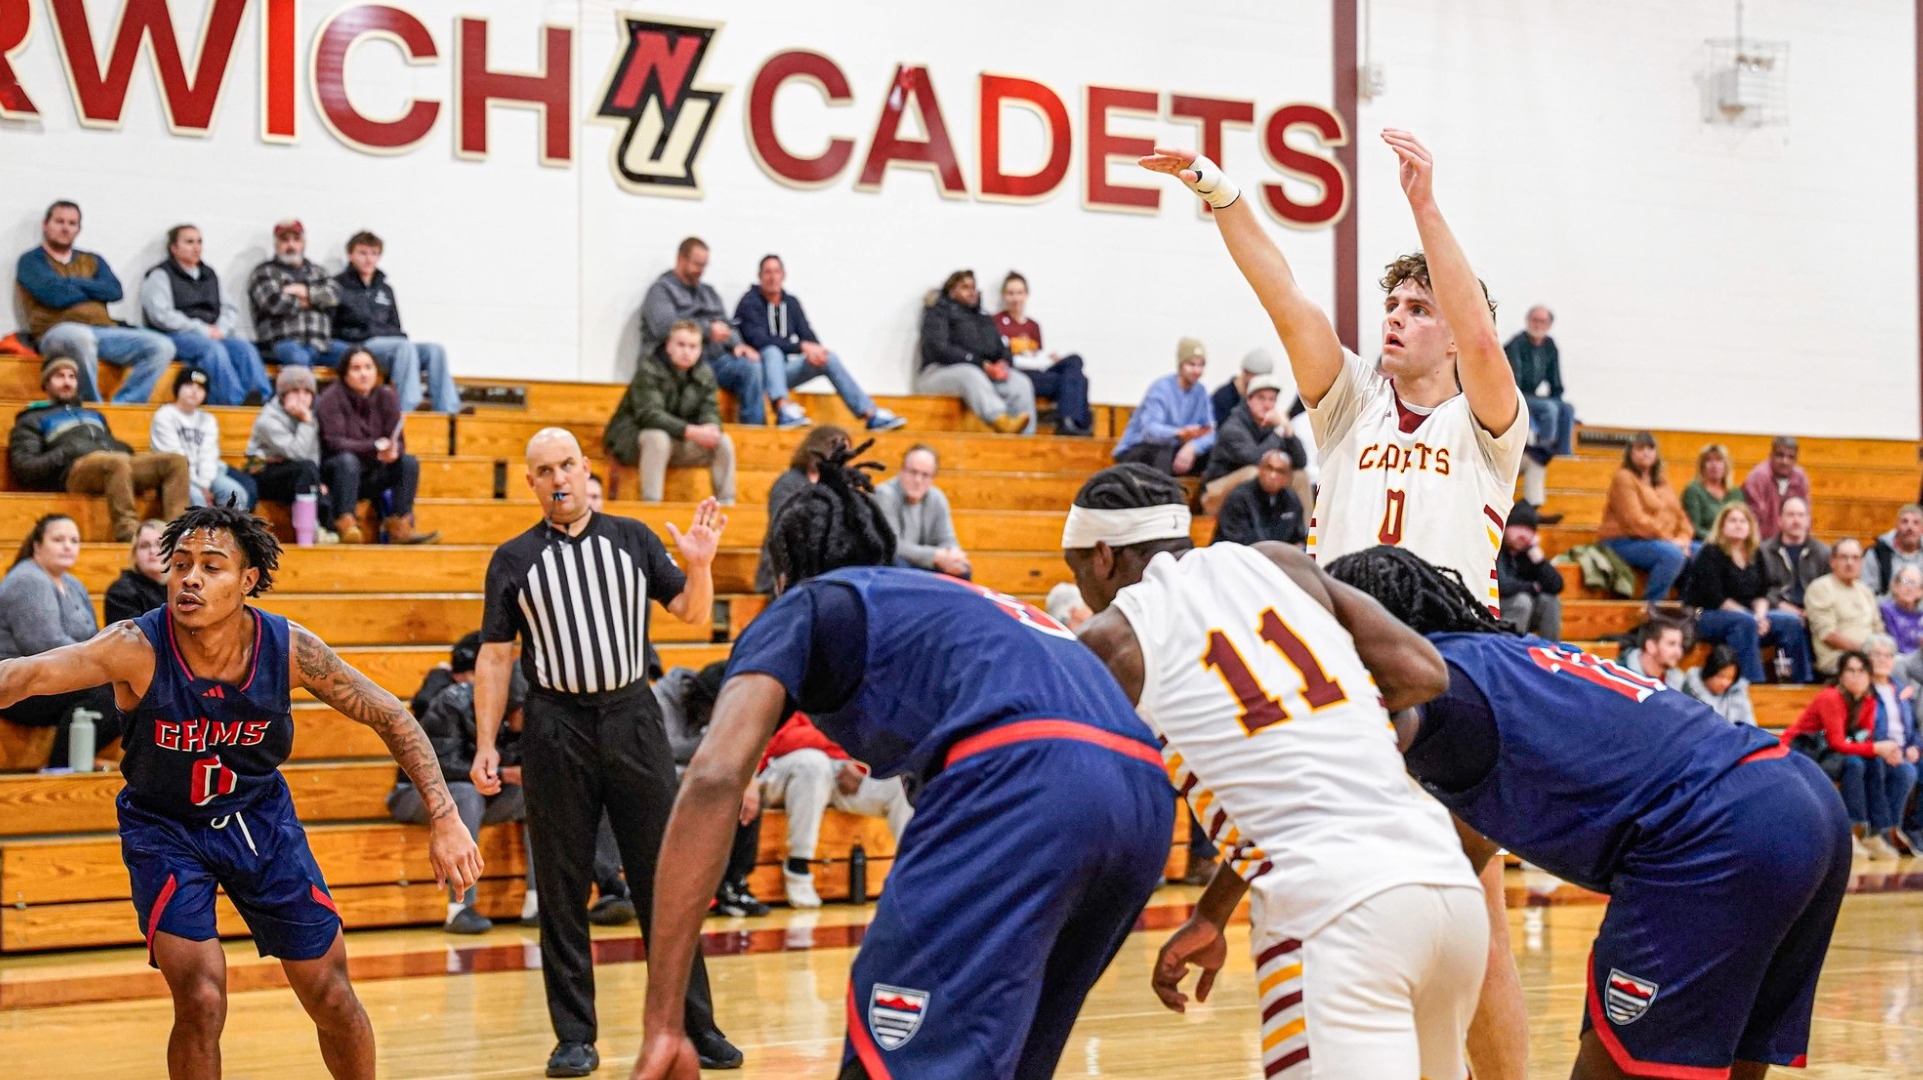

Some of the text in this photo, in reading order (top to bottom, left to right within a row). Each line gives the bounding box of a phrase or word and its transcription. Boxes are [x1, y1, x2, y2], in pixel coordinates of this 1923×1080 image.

[747, 49, 1348, 229] CADETS
[1377, 487, 1406, 546] 0
[1199, 606, 1349, 738] 11
[190, 754, 238, 806] 0
